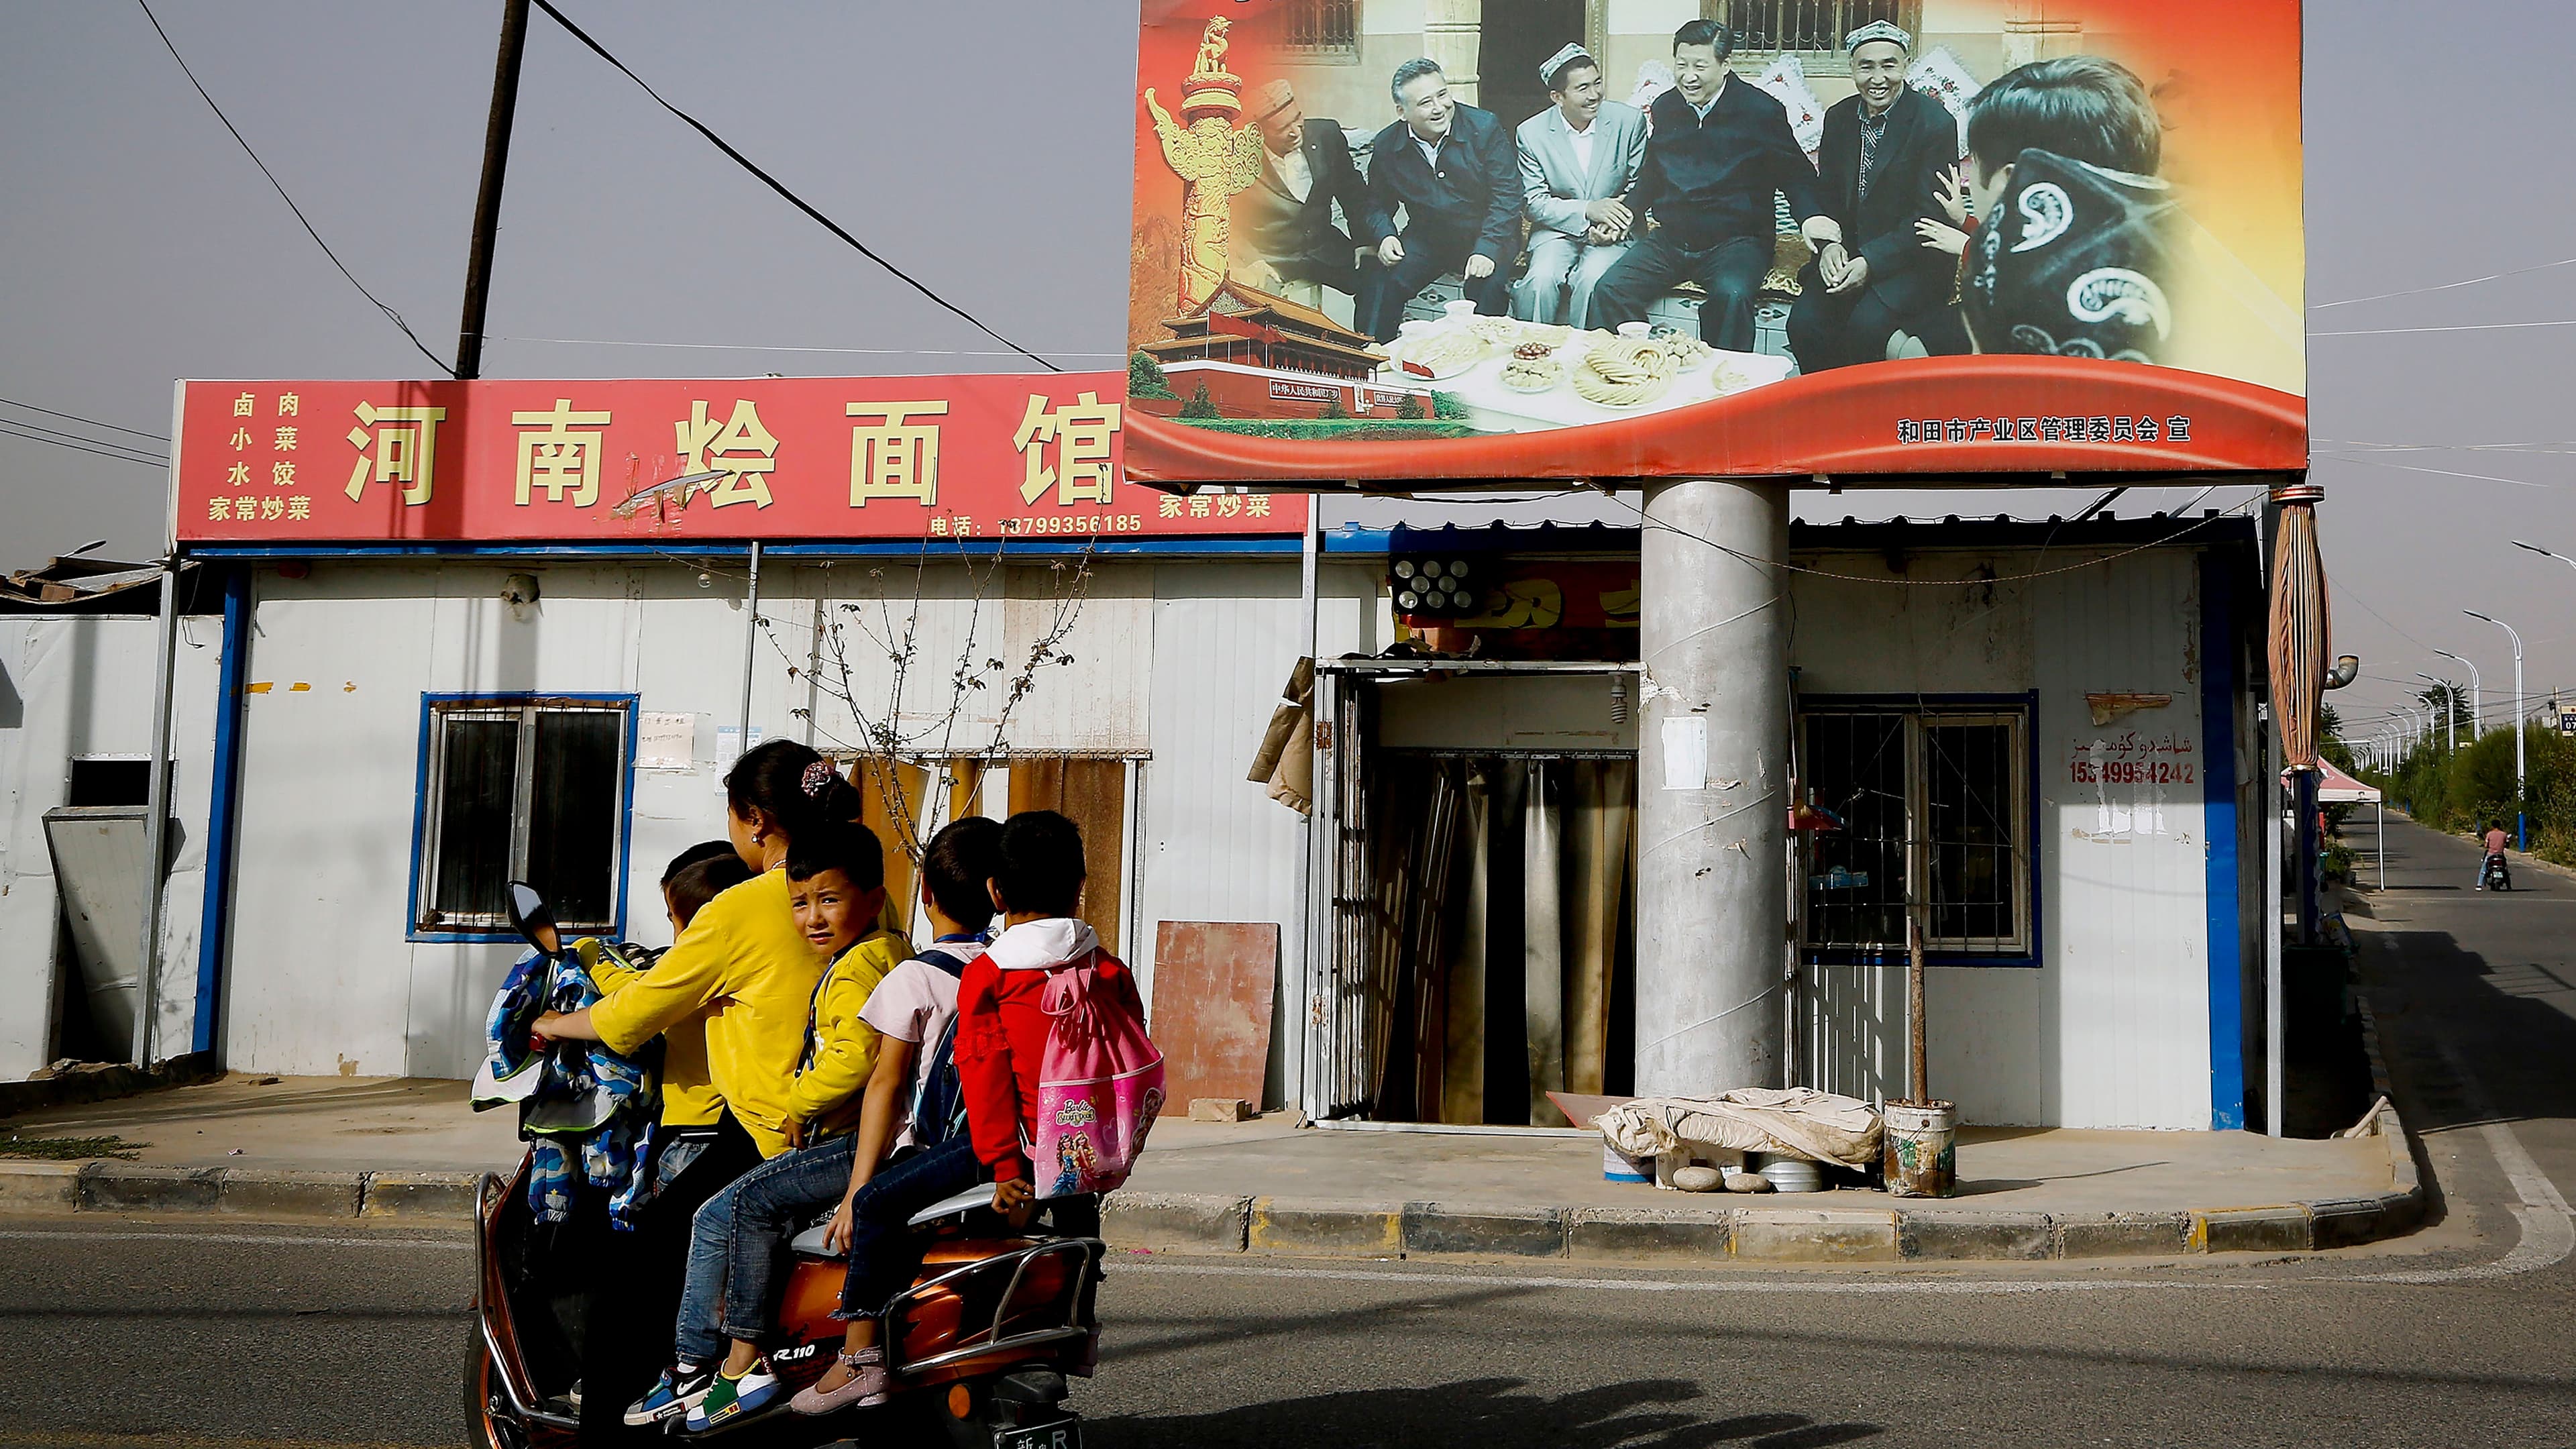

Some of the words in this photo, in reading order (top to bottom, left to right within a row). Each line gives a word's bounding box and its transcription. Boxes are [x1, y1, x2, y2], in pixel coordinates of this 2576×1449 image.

[1897, 415, 2159, 443] 和田市产业区管理委员会
[2167, 415, 2191, 442] 宣
[344, 390, 1121, 509] 河南烩面馆
[208, 495, 311, 522] 家常炒菜
[1159, 494, 1271, 519] 家常炒菜
[998, 515, 1141, 535] 13799356185
